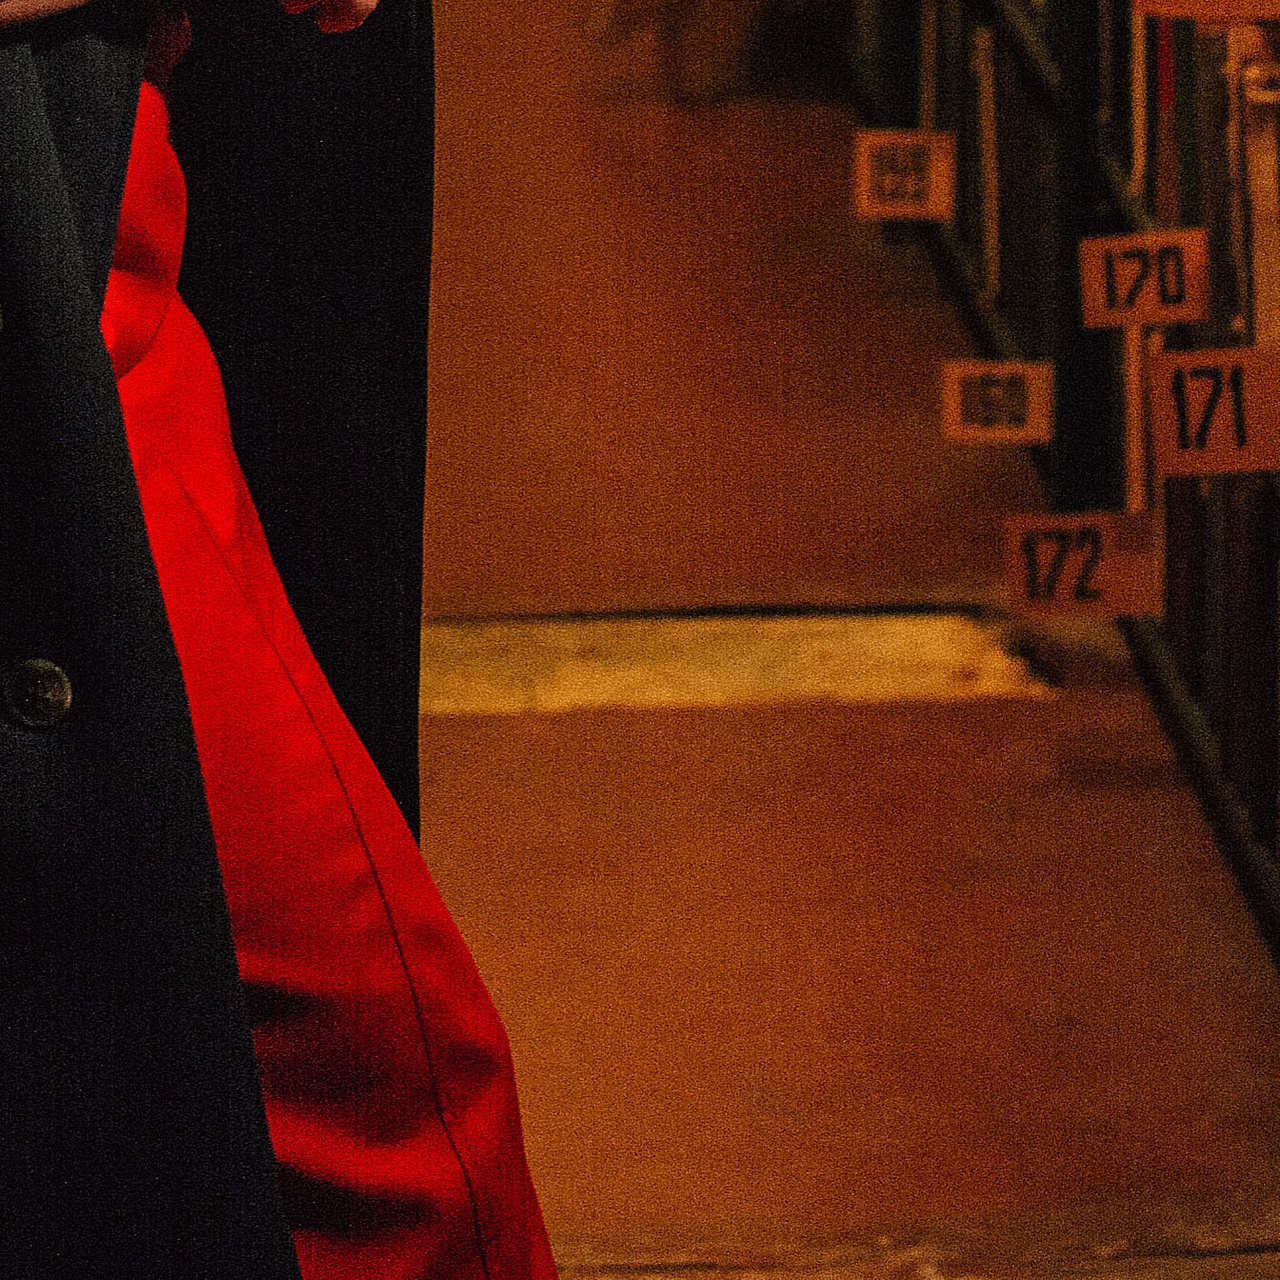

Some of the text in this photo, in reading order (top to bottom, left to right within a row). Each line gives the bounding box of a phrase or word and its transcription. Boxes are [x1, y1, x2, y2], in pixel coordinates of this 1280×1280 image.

[1103, 244, 1186, 310] 170
[1172, 364, 1248, 450] 171
[1022, 525, 1104, 602] 172
